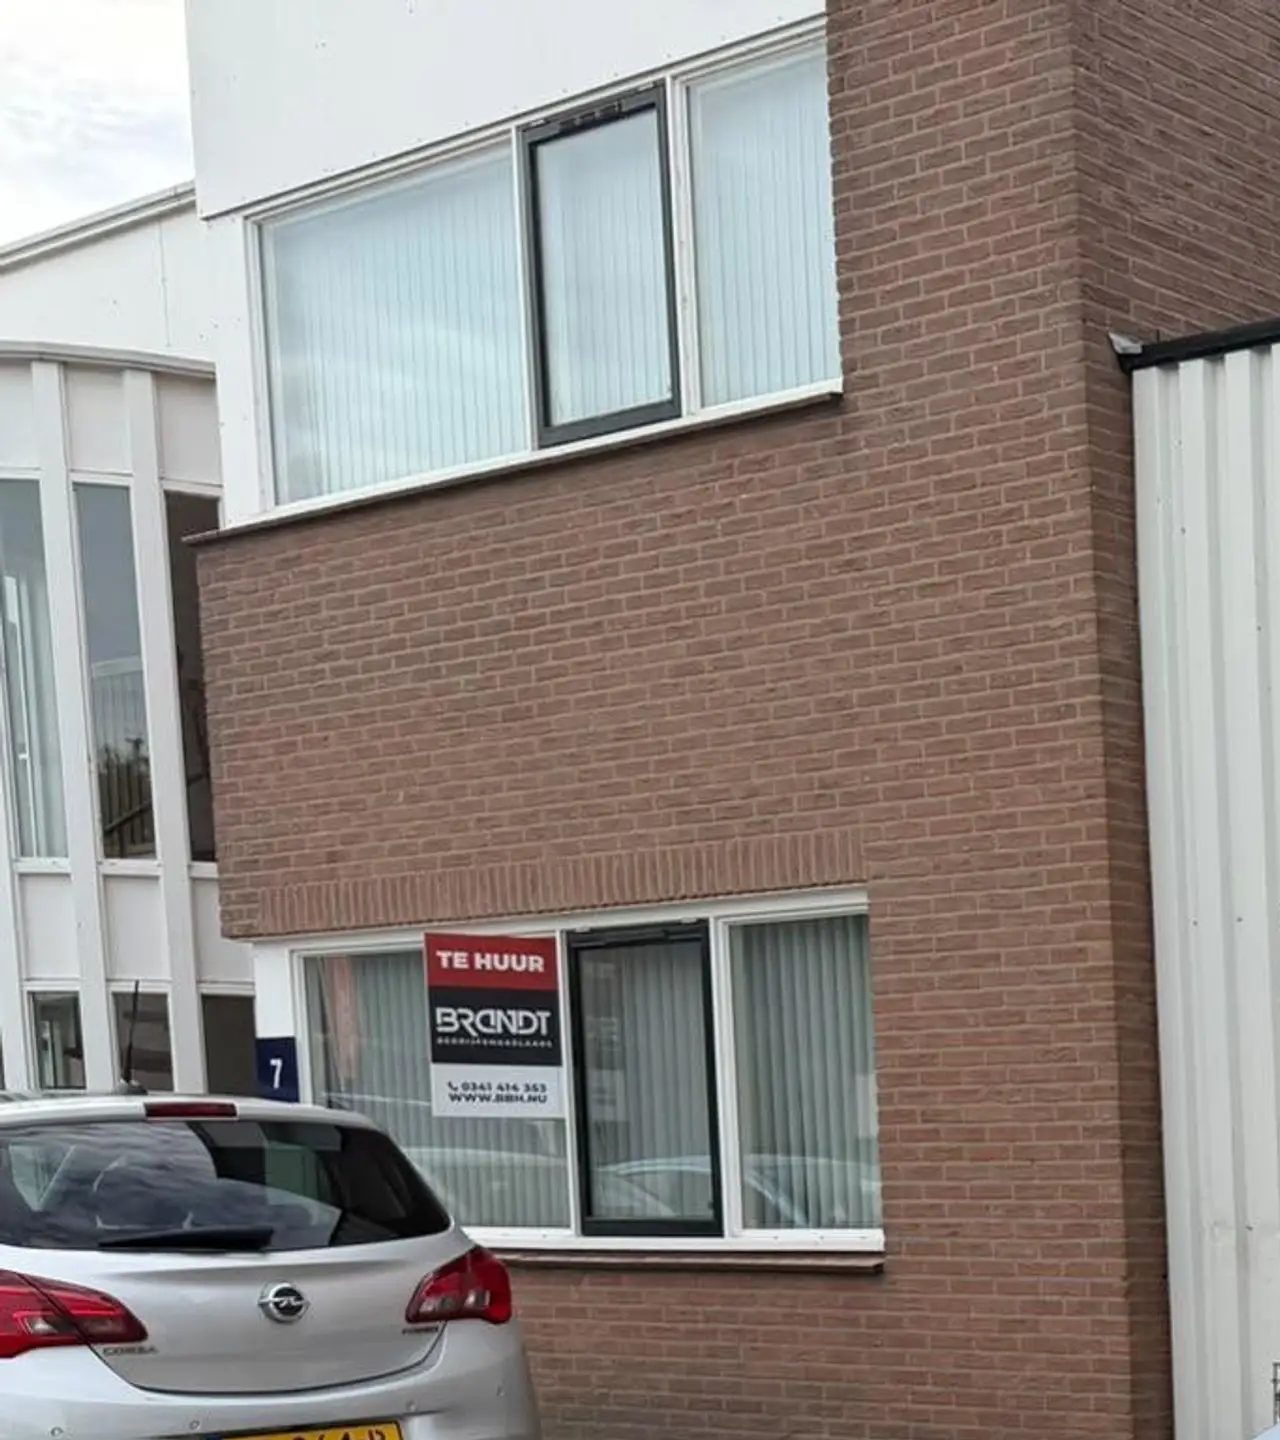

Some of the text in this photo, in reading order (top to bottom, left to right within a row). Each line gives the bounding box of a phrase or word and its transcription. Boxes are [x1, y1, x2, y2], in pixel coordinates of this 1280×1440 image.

[436, 950, 545, 973] TE HUUR
[435, 1006, 552, 1036] BRANDT
[269, 1058, 283, 1090] 7
[461, 1081, 493, 1093] 0341
